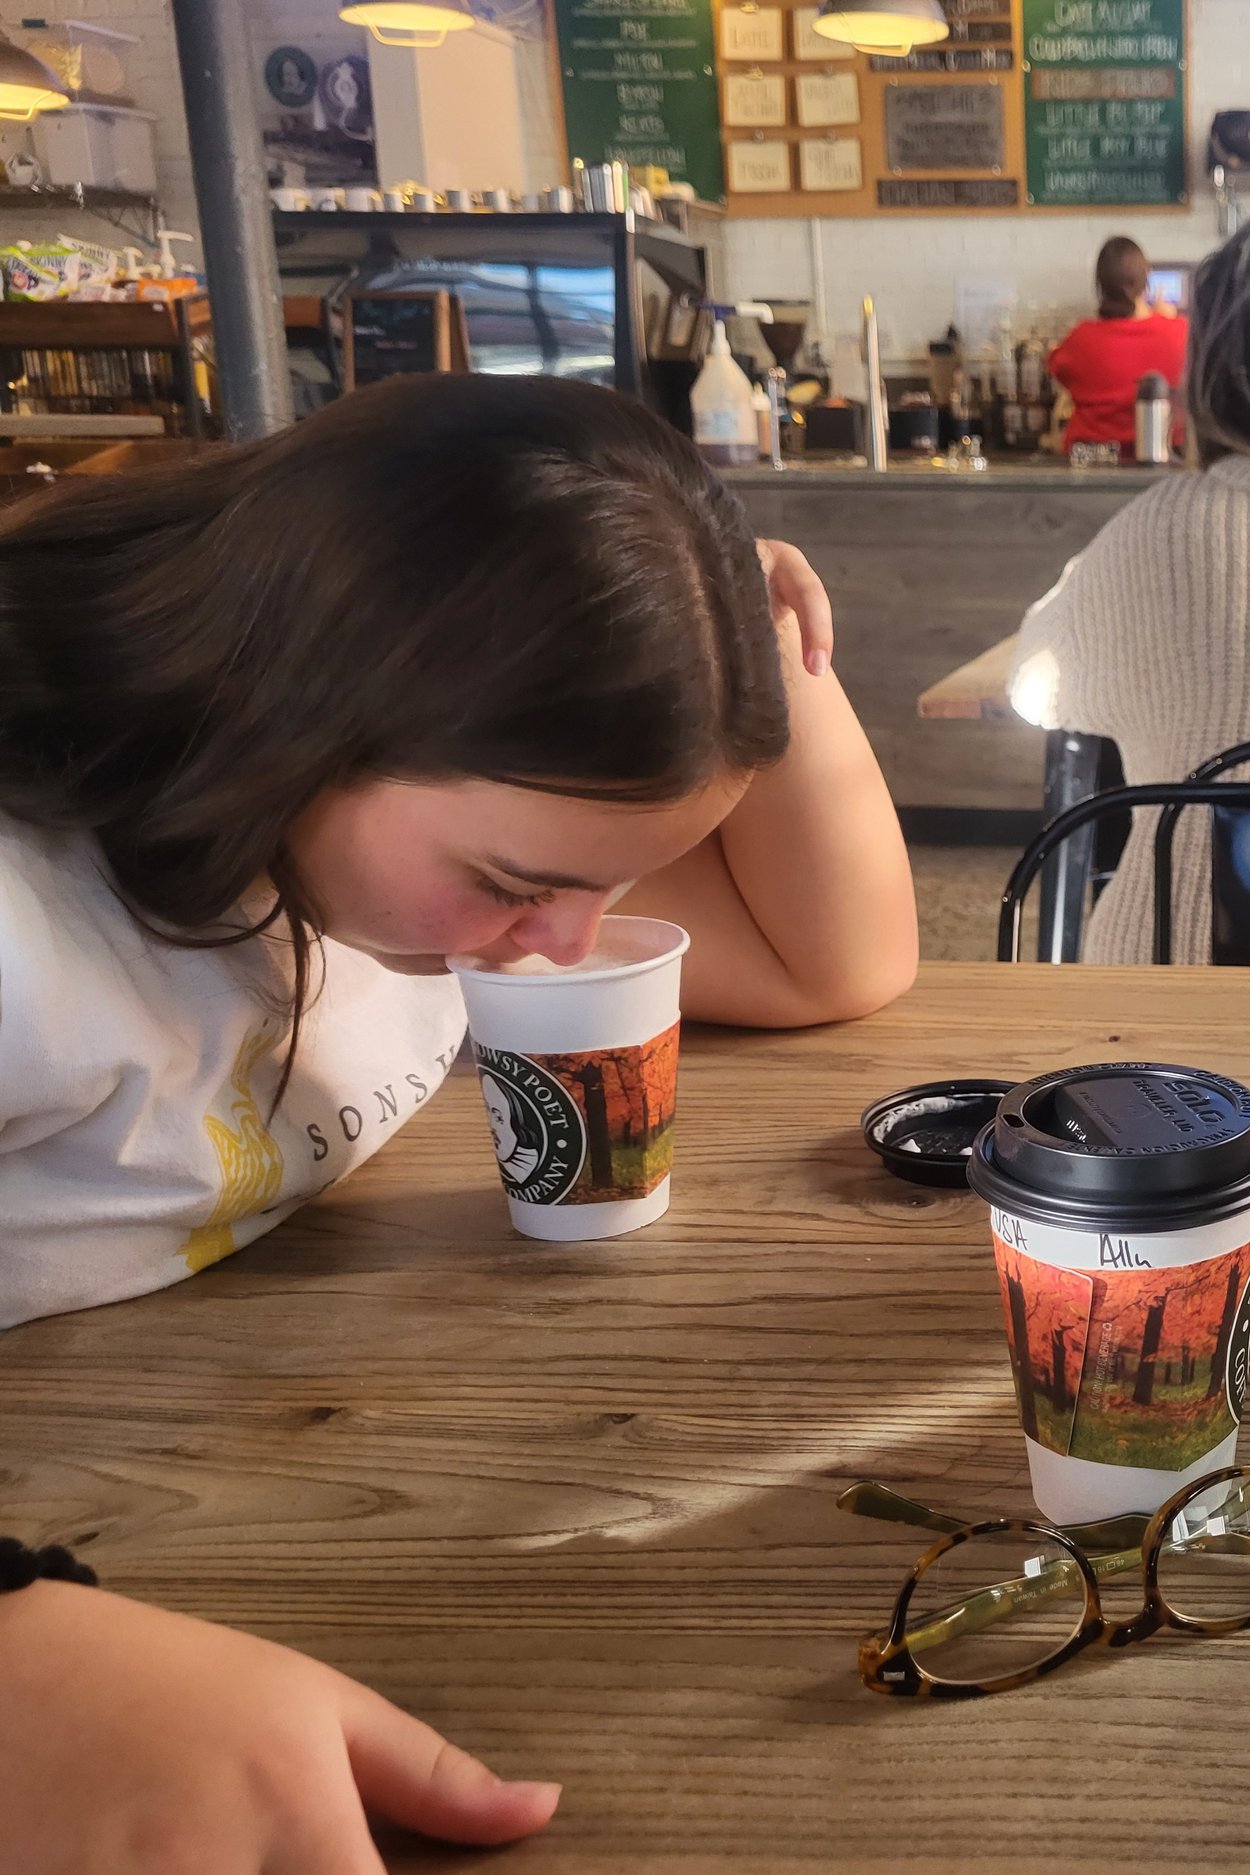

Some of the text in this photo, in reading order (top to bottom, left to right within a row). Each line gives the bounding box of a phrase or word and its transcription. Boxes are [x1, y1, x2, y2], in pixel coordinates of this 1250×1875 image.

[523, 1074, 569, 1130] POET
[1162, 1080, 1225, 1124] SOLO
[1049, 1579, 1069, 1591] Made
